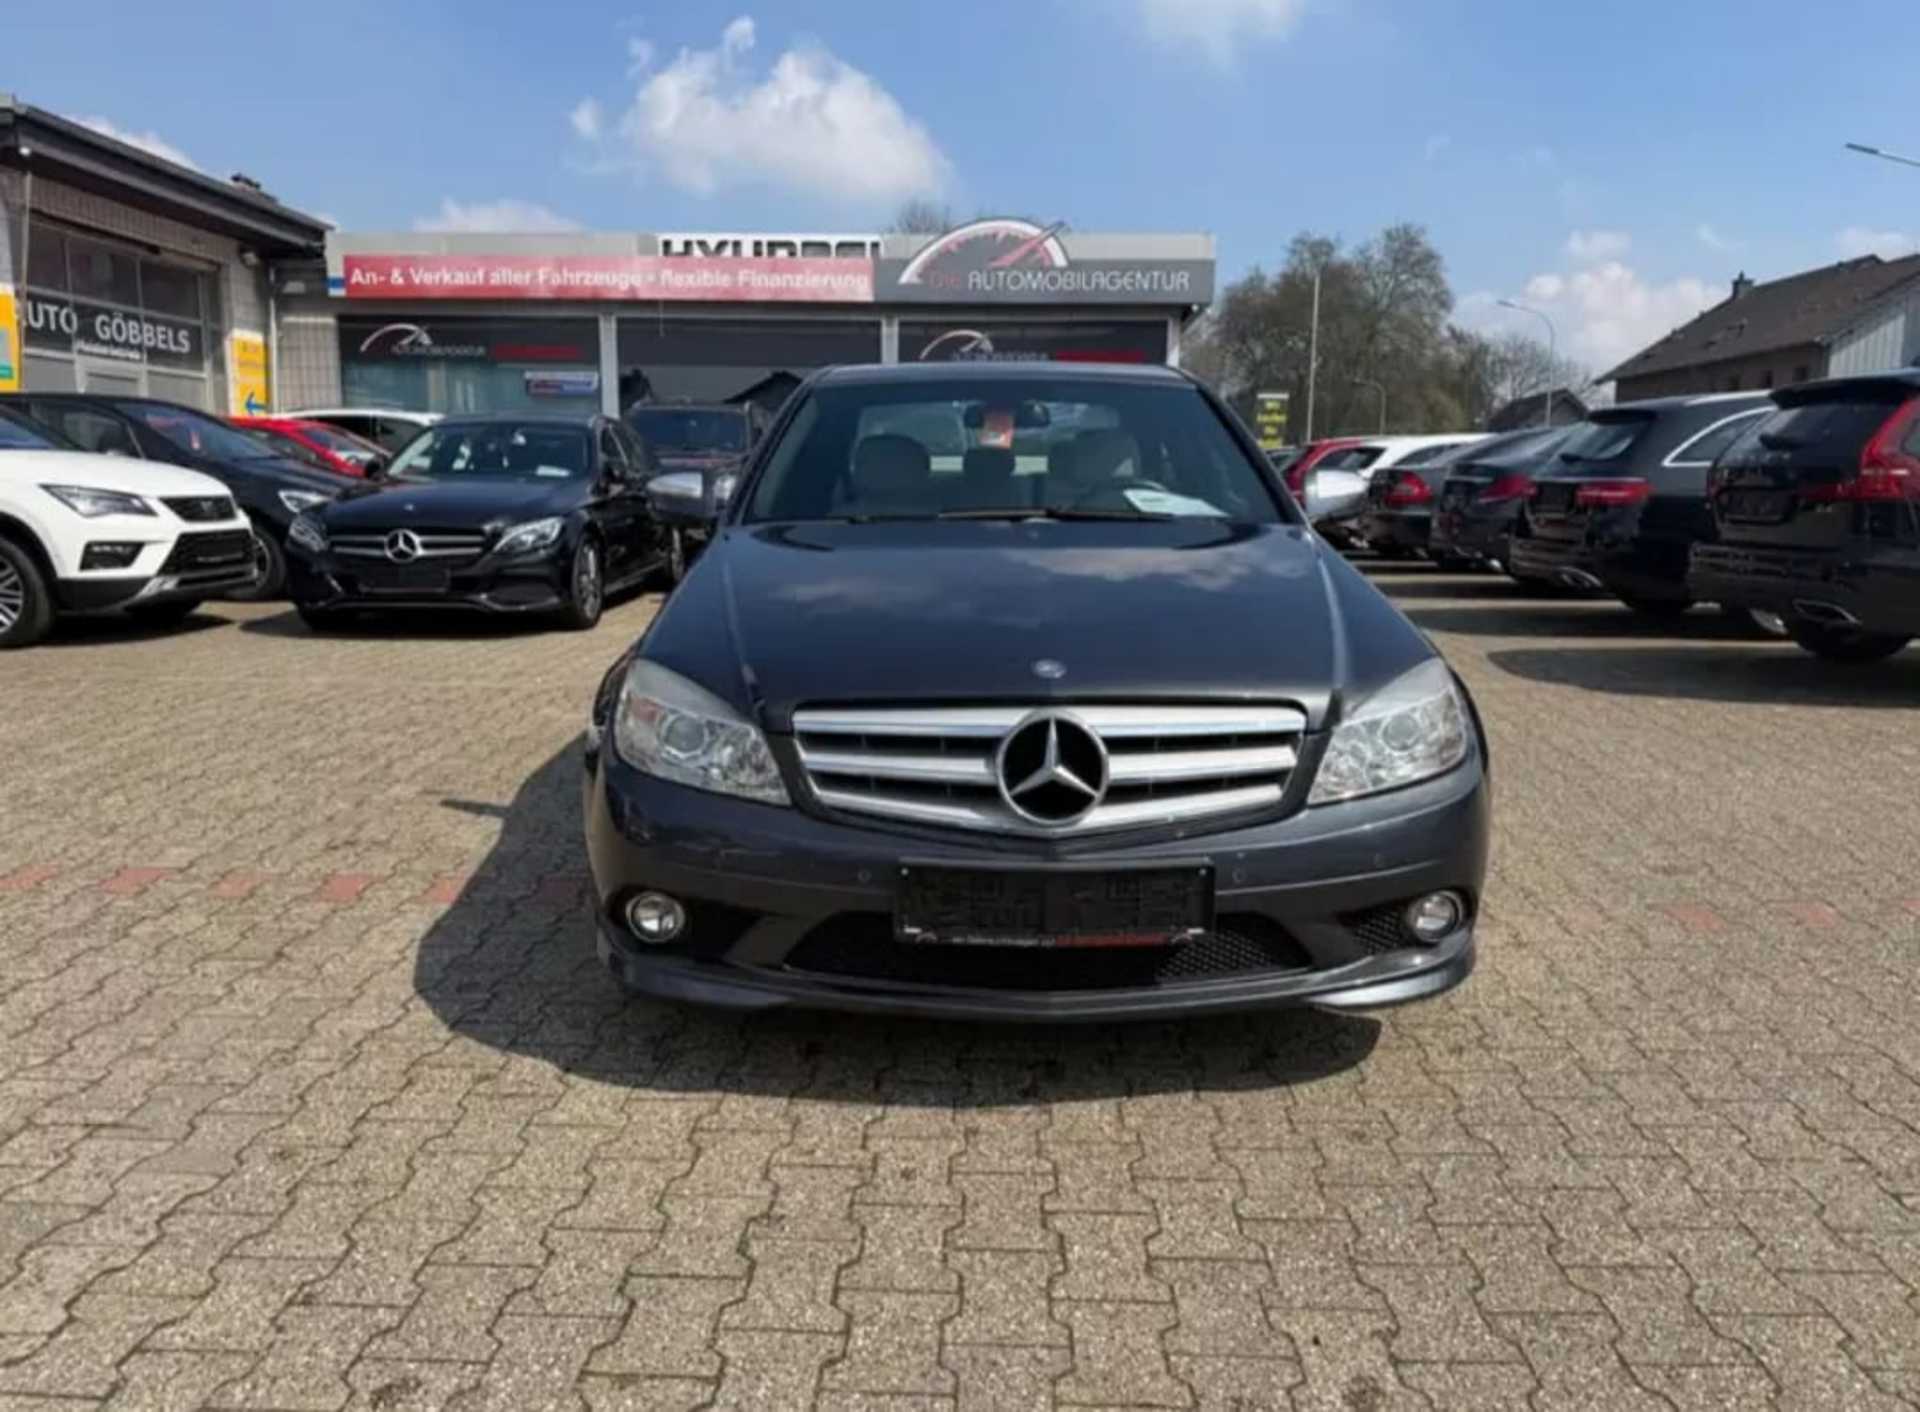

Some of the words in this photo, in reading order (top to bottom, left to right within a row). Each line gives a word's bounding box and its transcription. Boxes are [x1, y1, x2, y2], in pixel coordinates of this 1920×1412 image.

[351, 268, 384, 286] An-
[390, 268, 405, 286] &
[410, 268, 484, 286] Verkauf
[489, 268, 532, 286] aller
[538, 268, 641, 290] Fahrzeuge
[660, 269, 731, 287] flexible
[738, 270, 869, 290] Finanzierung
[968, 270, 1191, 292] AUTOMOBILAGENTUR
[95, 311, 191, 353] GÖBBELS
